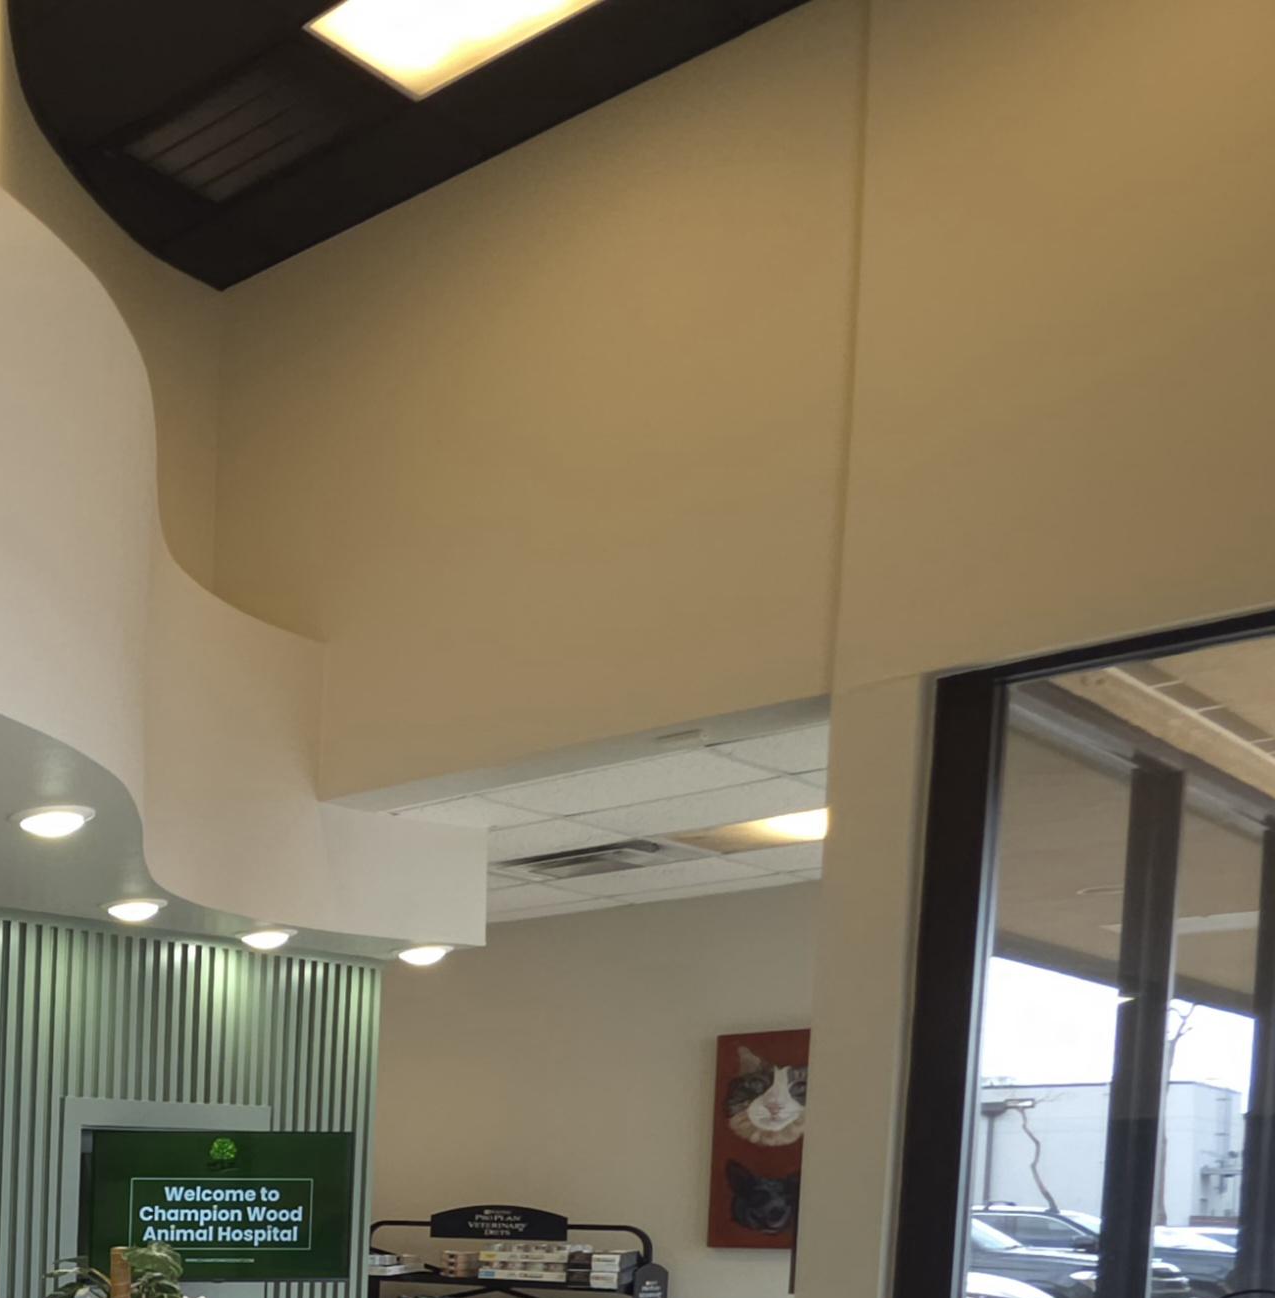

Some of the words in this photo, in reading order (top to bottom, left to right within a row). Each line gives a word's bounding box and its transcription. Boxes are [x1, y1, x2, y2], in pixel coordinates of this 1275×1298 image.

[164, 1186, 256, 1202] Welcome
[260, 1186, 280, 1202] to
[139, 1205, 242, 1227] Champion
[246, 1206, 303, 1223] Wood
[142, 1225, 214, 1242] Animal
[217, 1225, 298, 1247] Hospital
[467, 1221, 529, 1232] VETERINARY
